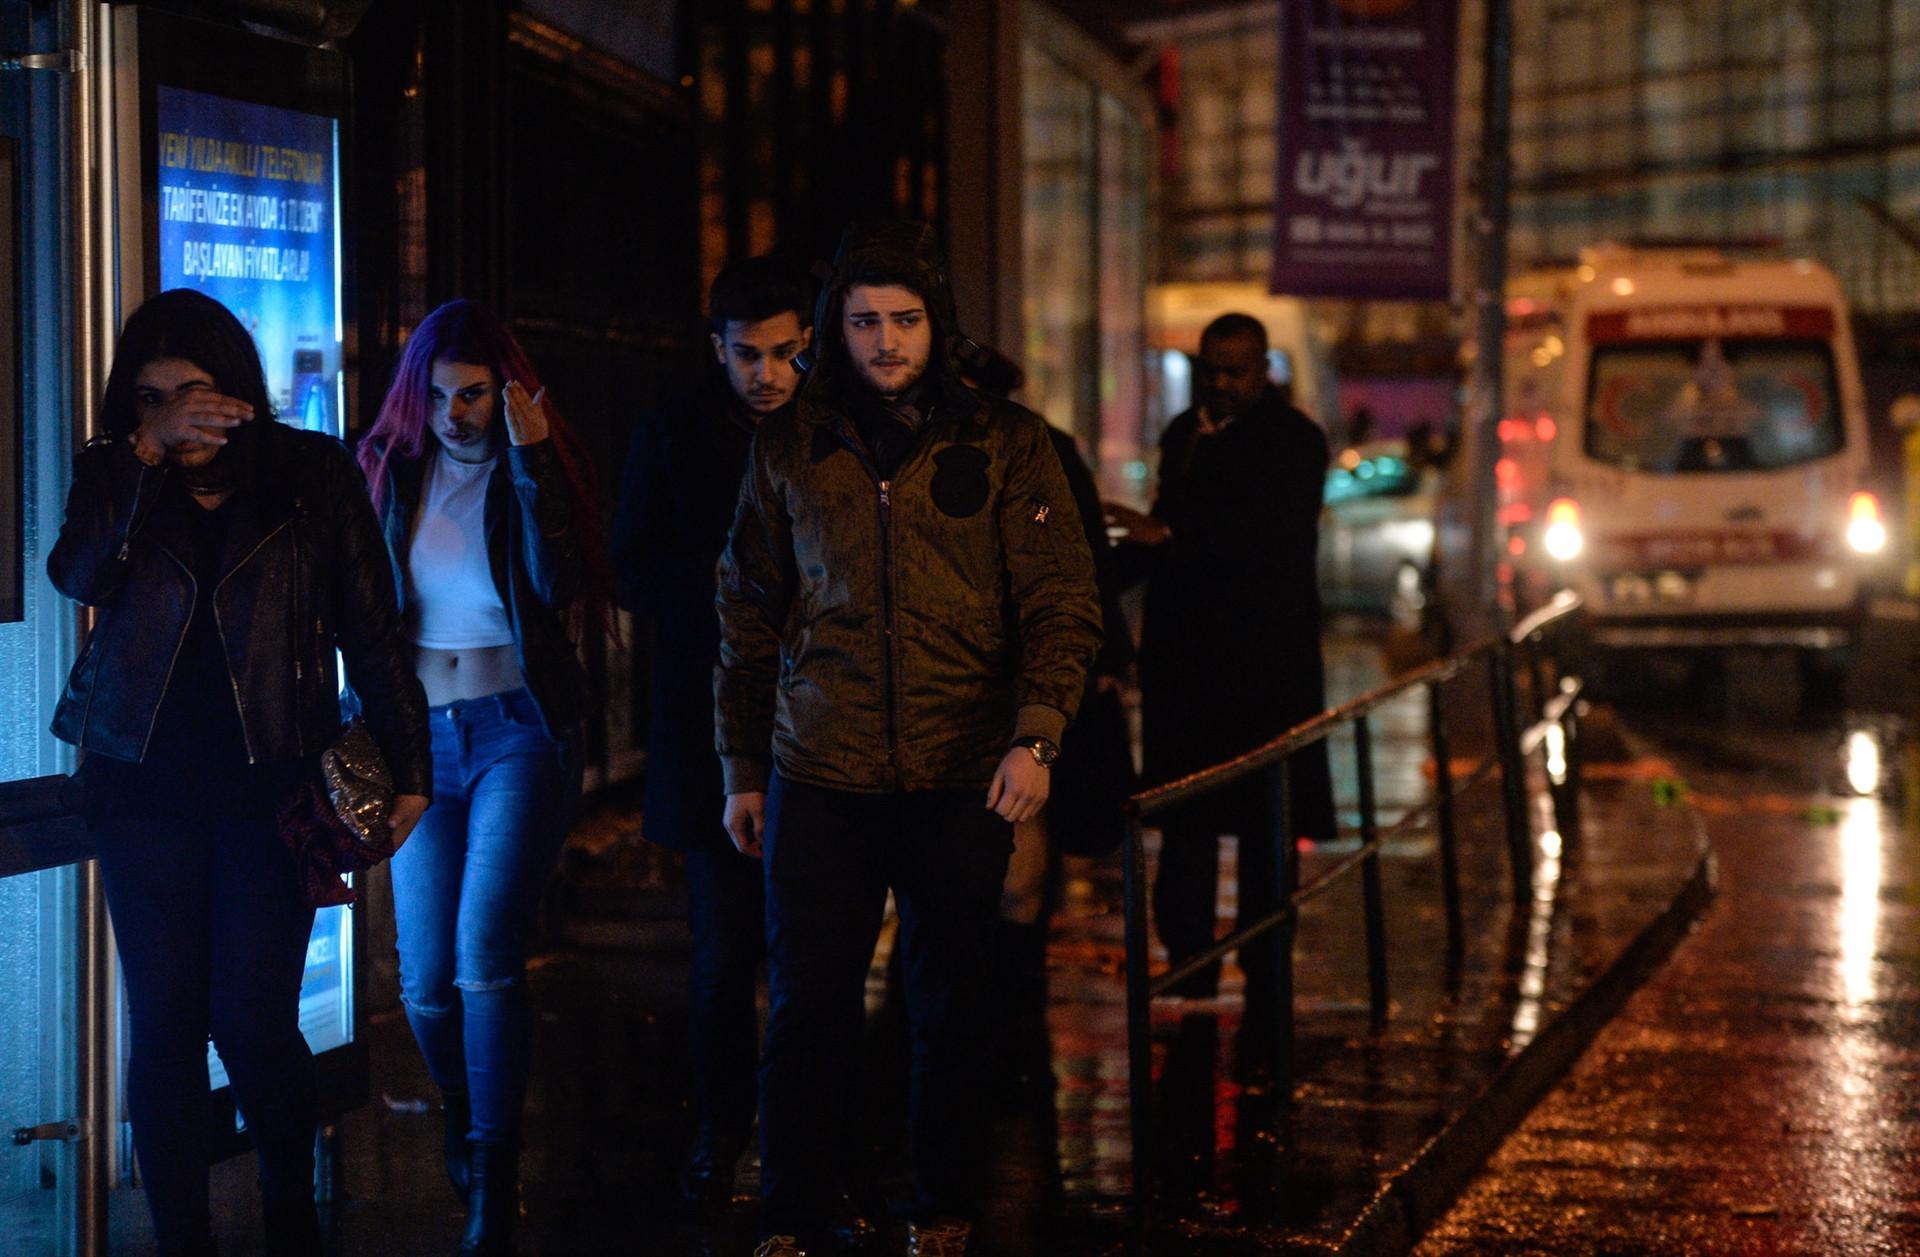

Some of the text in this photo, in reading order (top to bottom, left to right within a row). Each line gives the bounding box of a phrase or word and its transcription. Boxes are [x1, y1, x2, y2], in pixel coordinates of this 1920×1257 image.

[1294, 135, 1440, 208] uğur
[163, 181, 230, 226] TARİFENİZE
[184, 241, 245, 283] BAŞLAYAN
